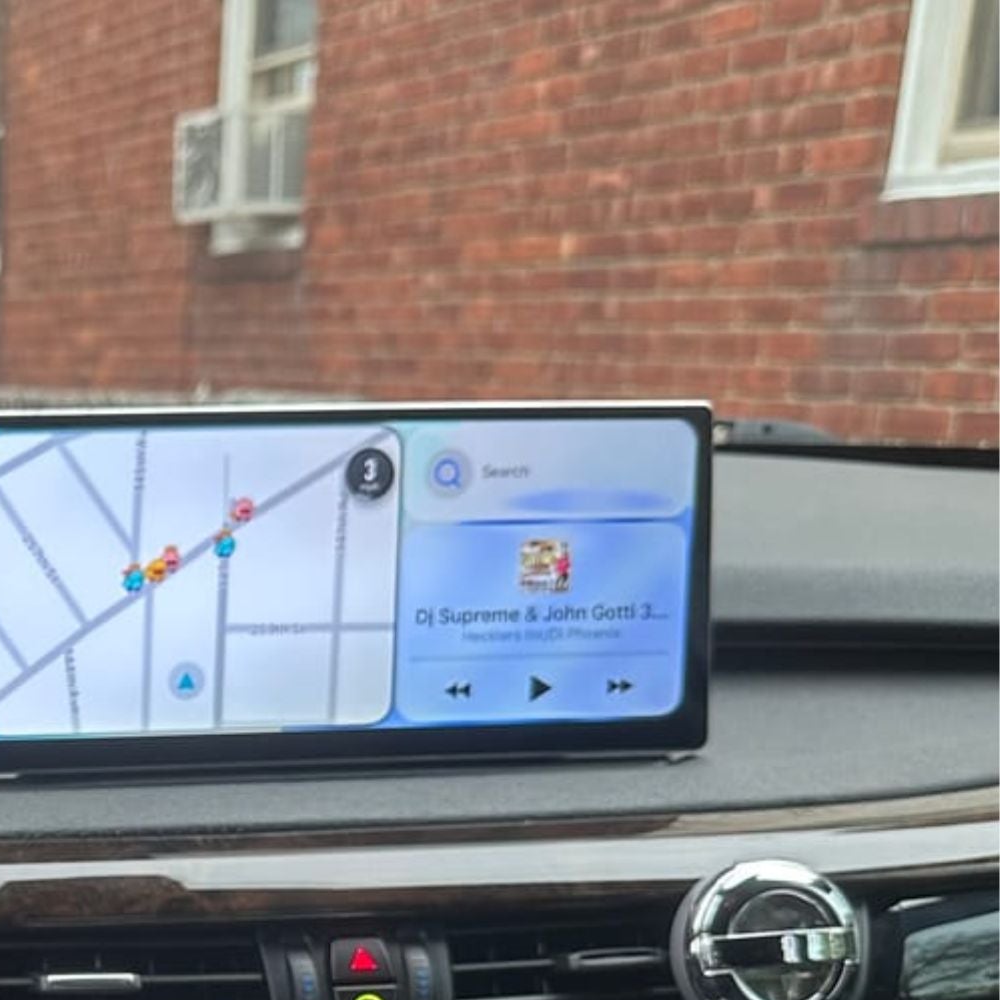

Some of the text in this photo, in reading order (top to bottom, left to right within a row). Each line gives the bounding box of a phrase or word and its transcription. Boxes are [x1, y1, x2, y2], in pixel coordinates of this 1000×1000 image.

[363, 458, 378, 482] 3
[481, 464, 529, 480] Search
[438, 605, 520, 627] Supreme
[525, 606, 539, 622] &
[542, 604, 588, 622] John
